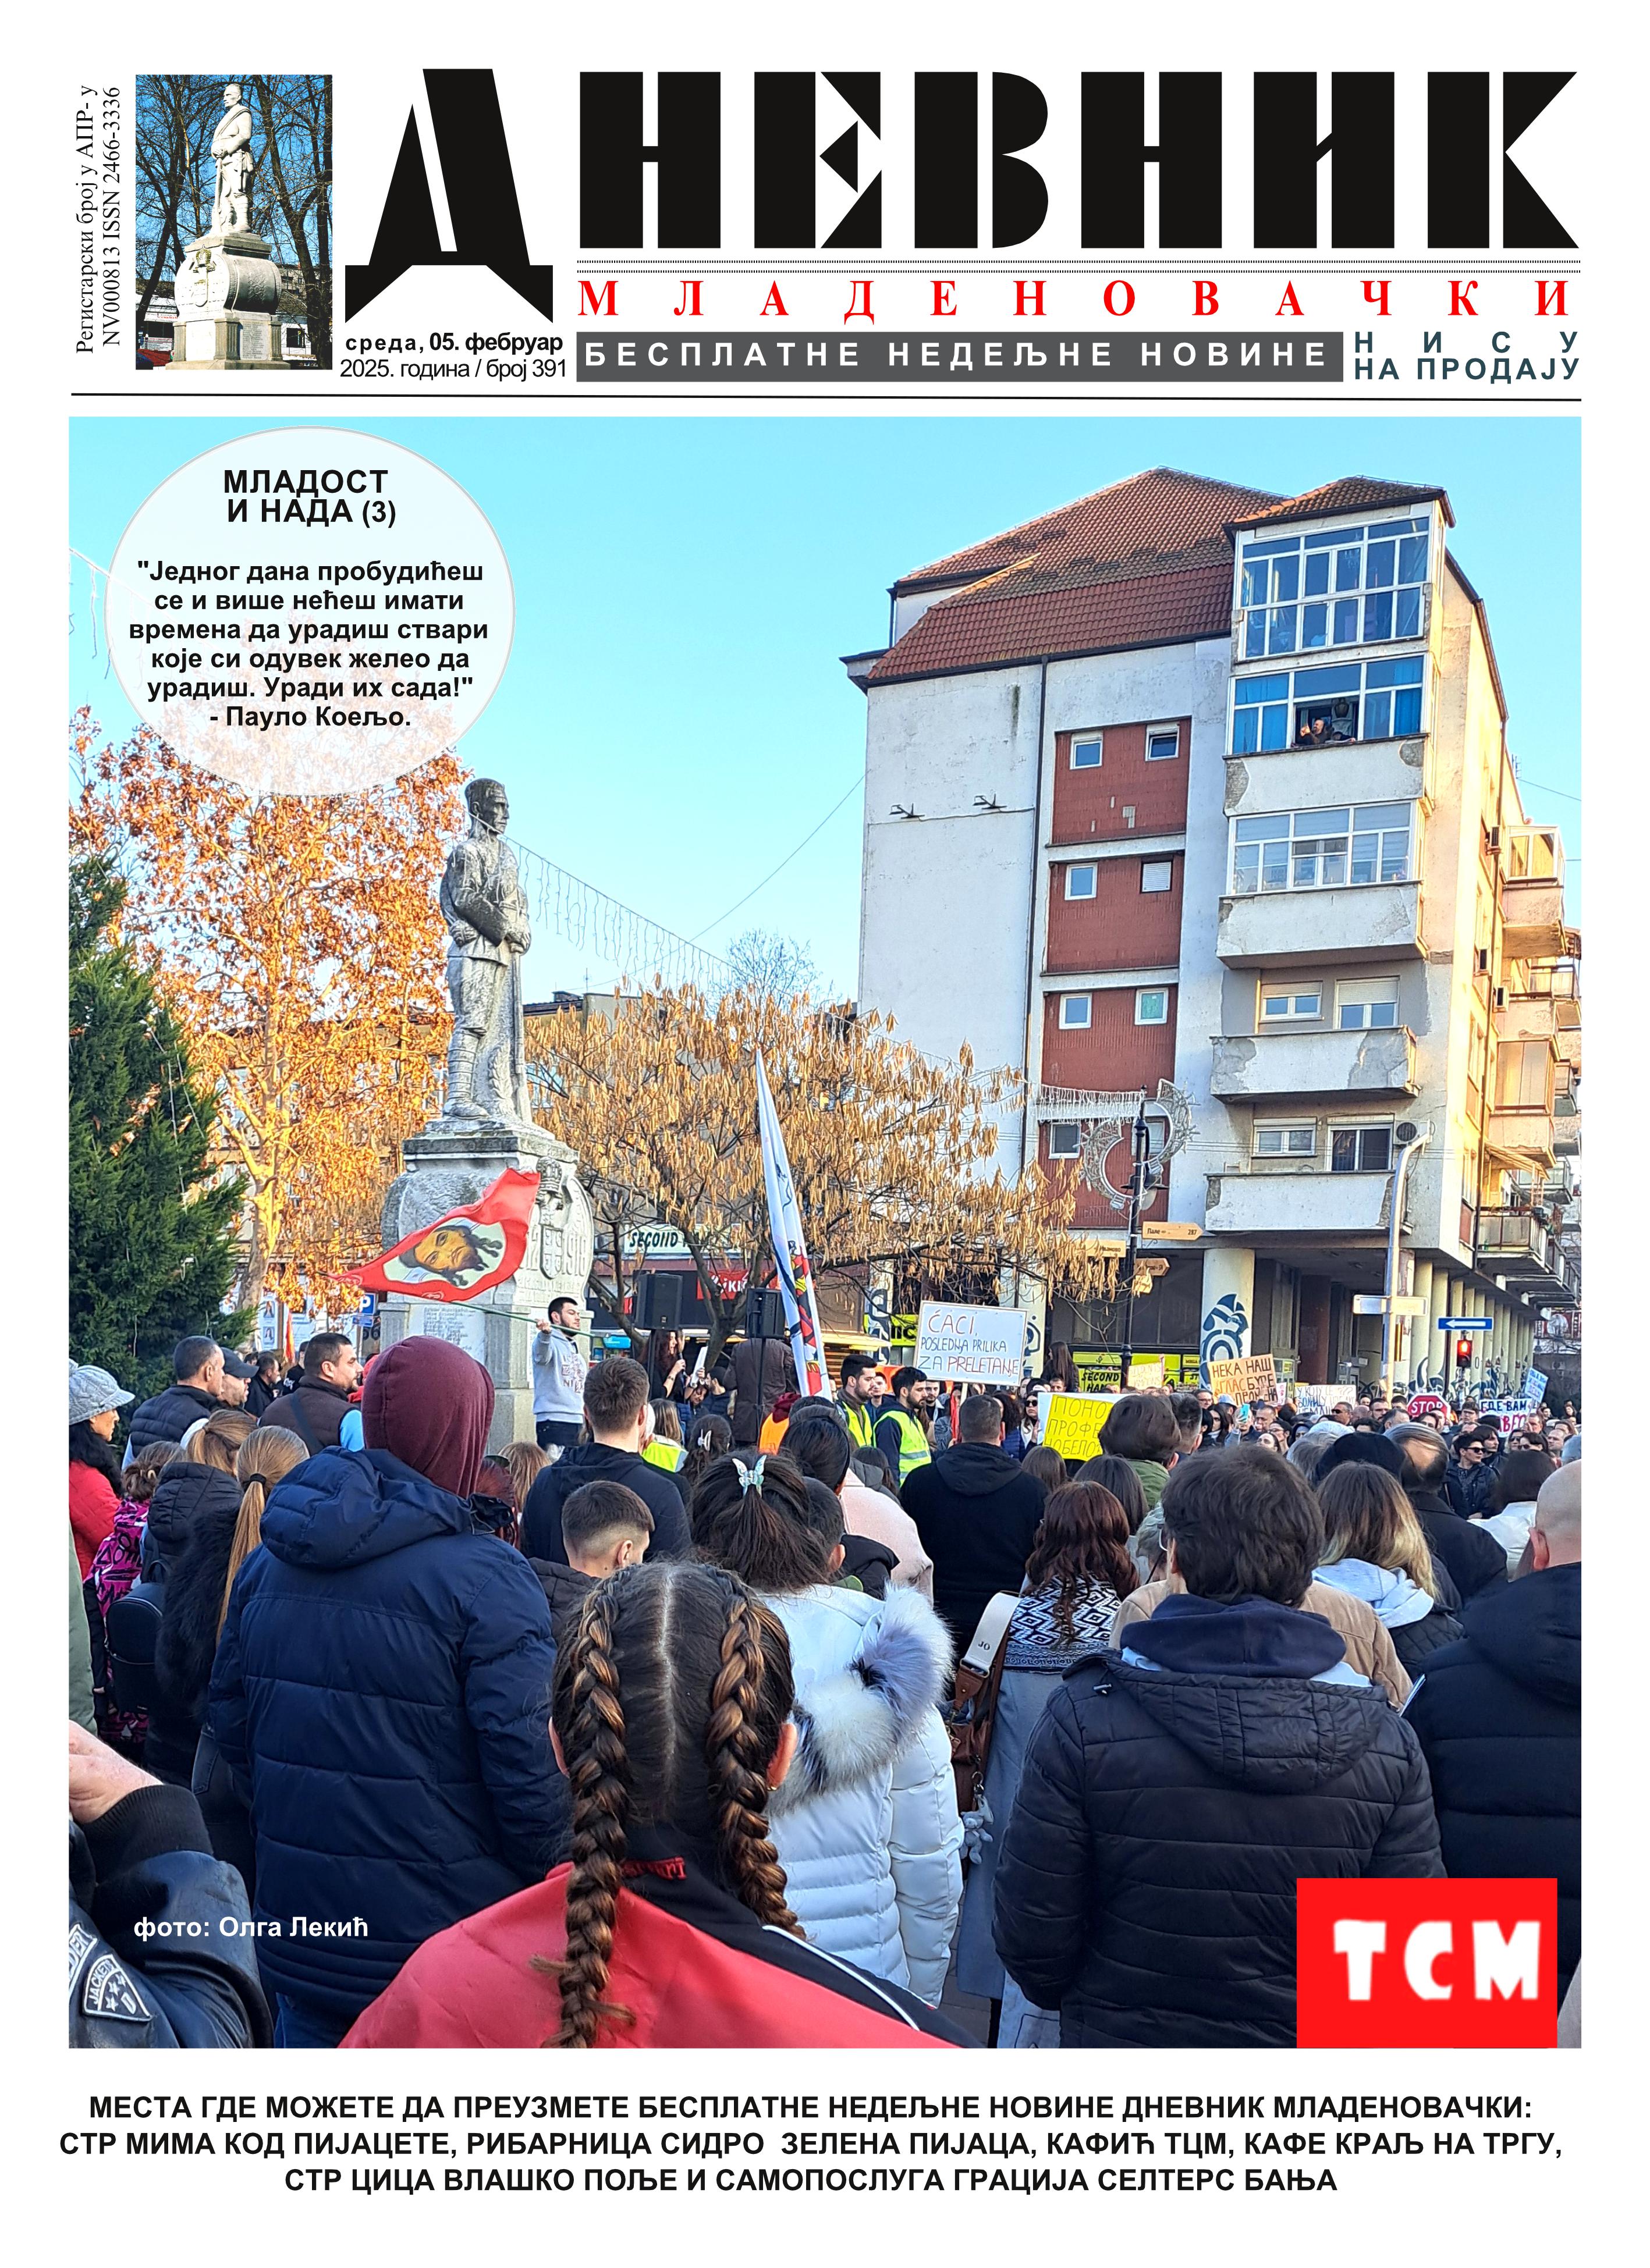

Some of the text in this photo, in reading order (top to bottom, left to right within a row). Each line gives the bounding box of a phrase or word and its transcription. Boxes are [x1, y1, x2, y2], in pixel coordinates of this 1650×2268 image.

[928, 1309, 978, 1336] ĆACI,
[973, 1339, 1007, 1352] PRILIKA
[918, 1356, 1019, 1377] ZA PRELETANJE
[1212, 1357, 1272, 1378] НЕКА НАШ
[1081, 1373, 1120, 1382] SECOND
[1411, 1401, 1443, 1413] STOP
[1506, 1400, 1527, 1412] ВАМ
